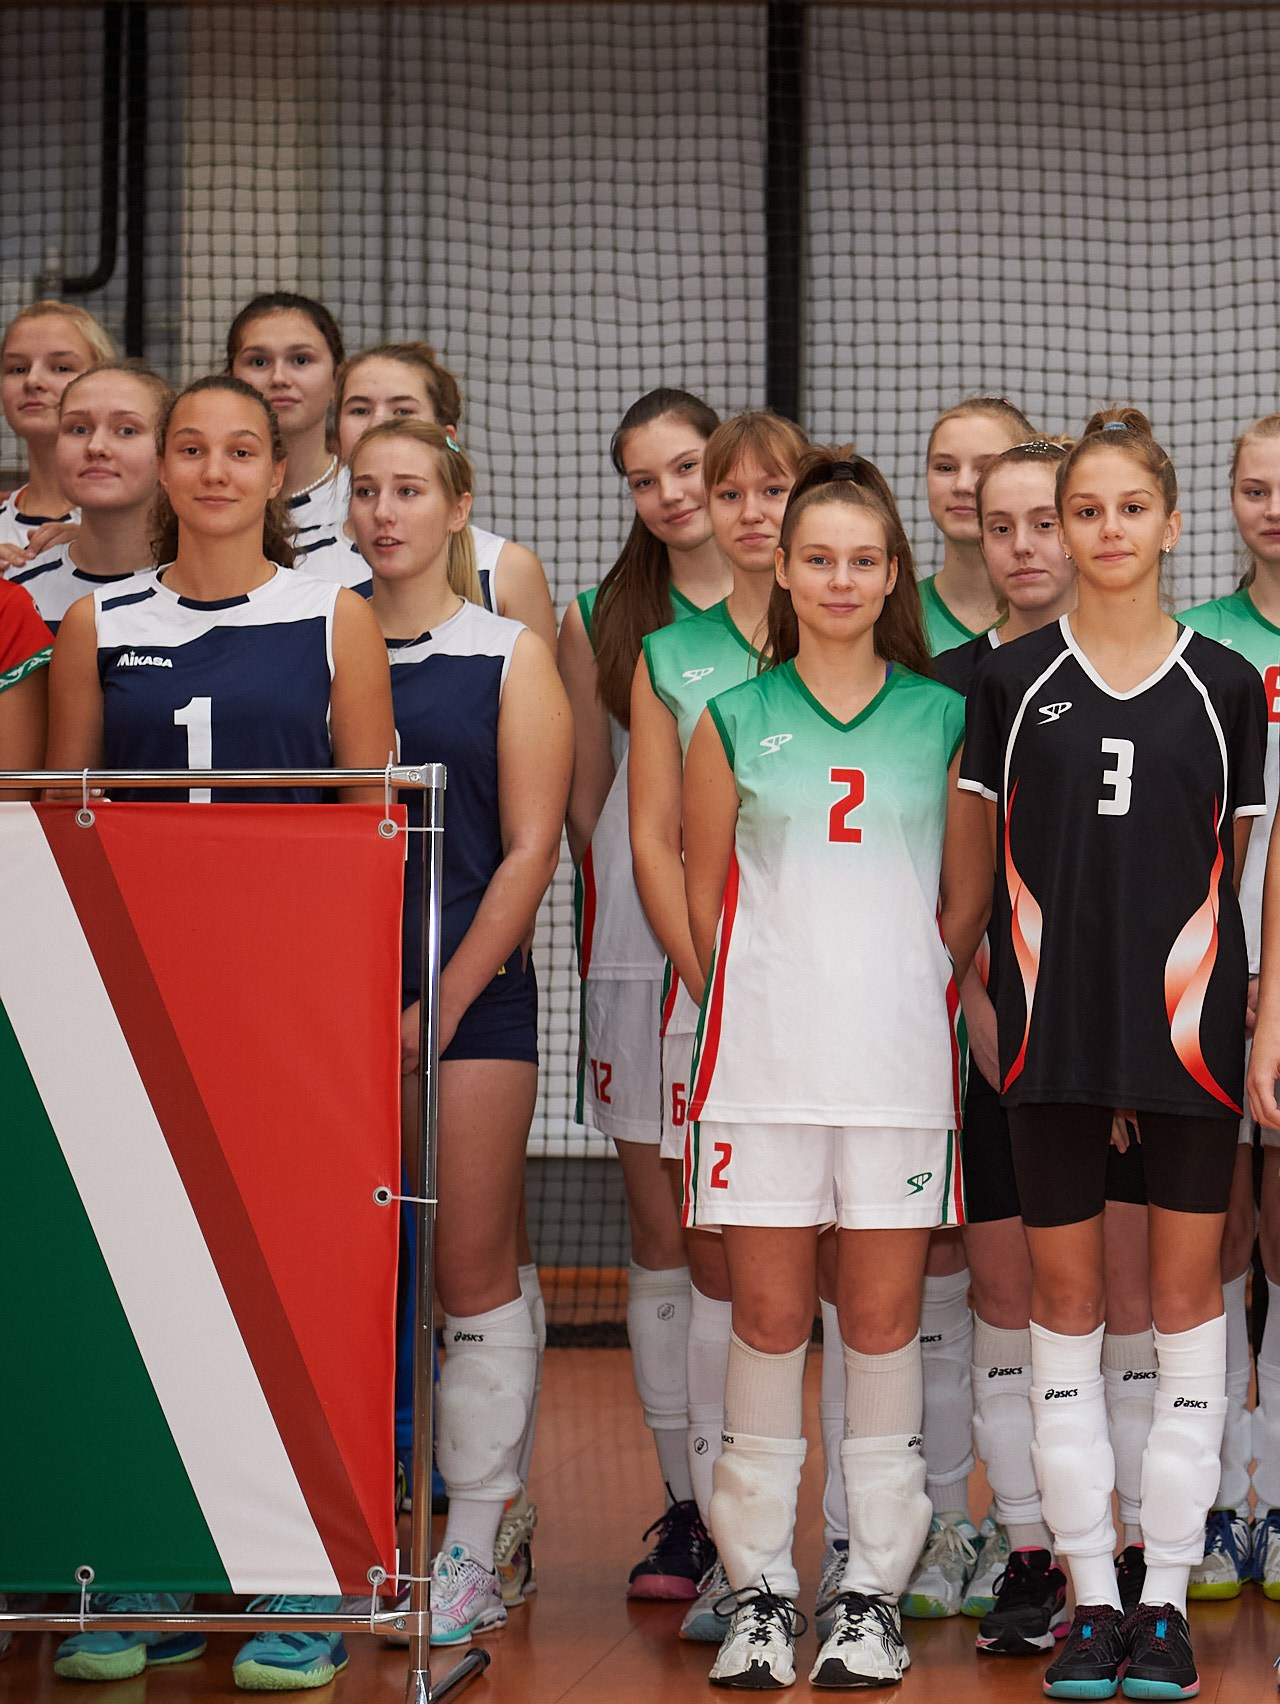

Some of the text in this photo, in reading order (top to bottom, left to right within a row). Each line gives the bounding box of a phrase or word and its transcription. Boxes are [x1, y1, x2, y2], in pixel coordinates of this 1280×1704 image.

[173, 696, 212, 804] 1
[1097, 737, 1135, 816] 3
[828, 766, 866, 844] 2
[590, 1058, 612, 1104] 12
[671, 1082, 687, 1126] 6
[710, 1141, 732, 1189] 2
